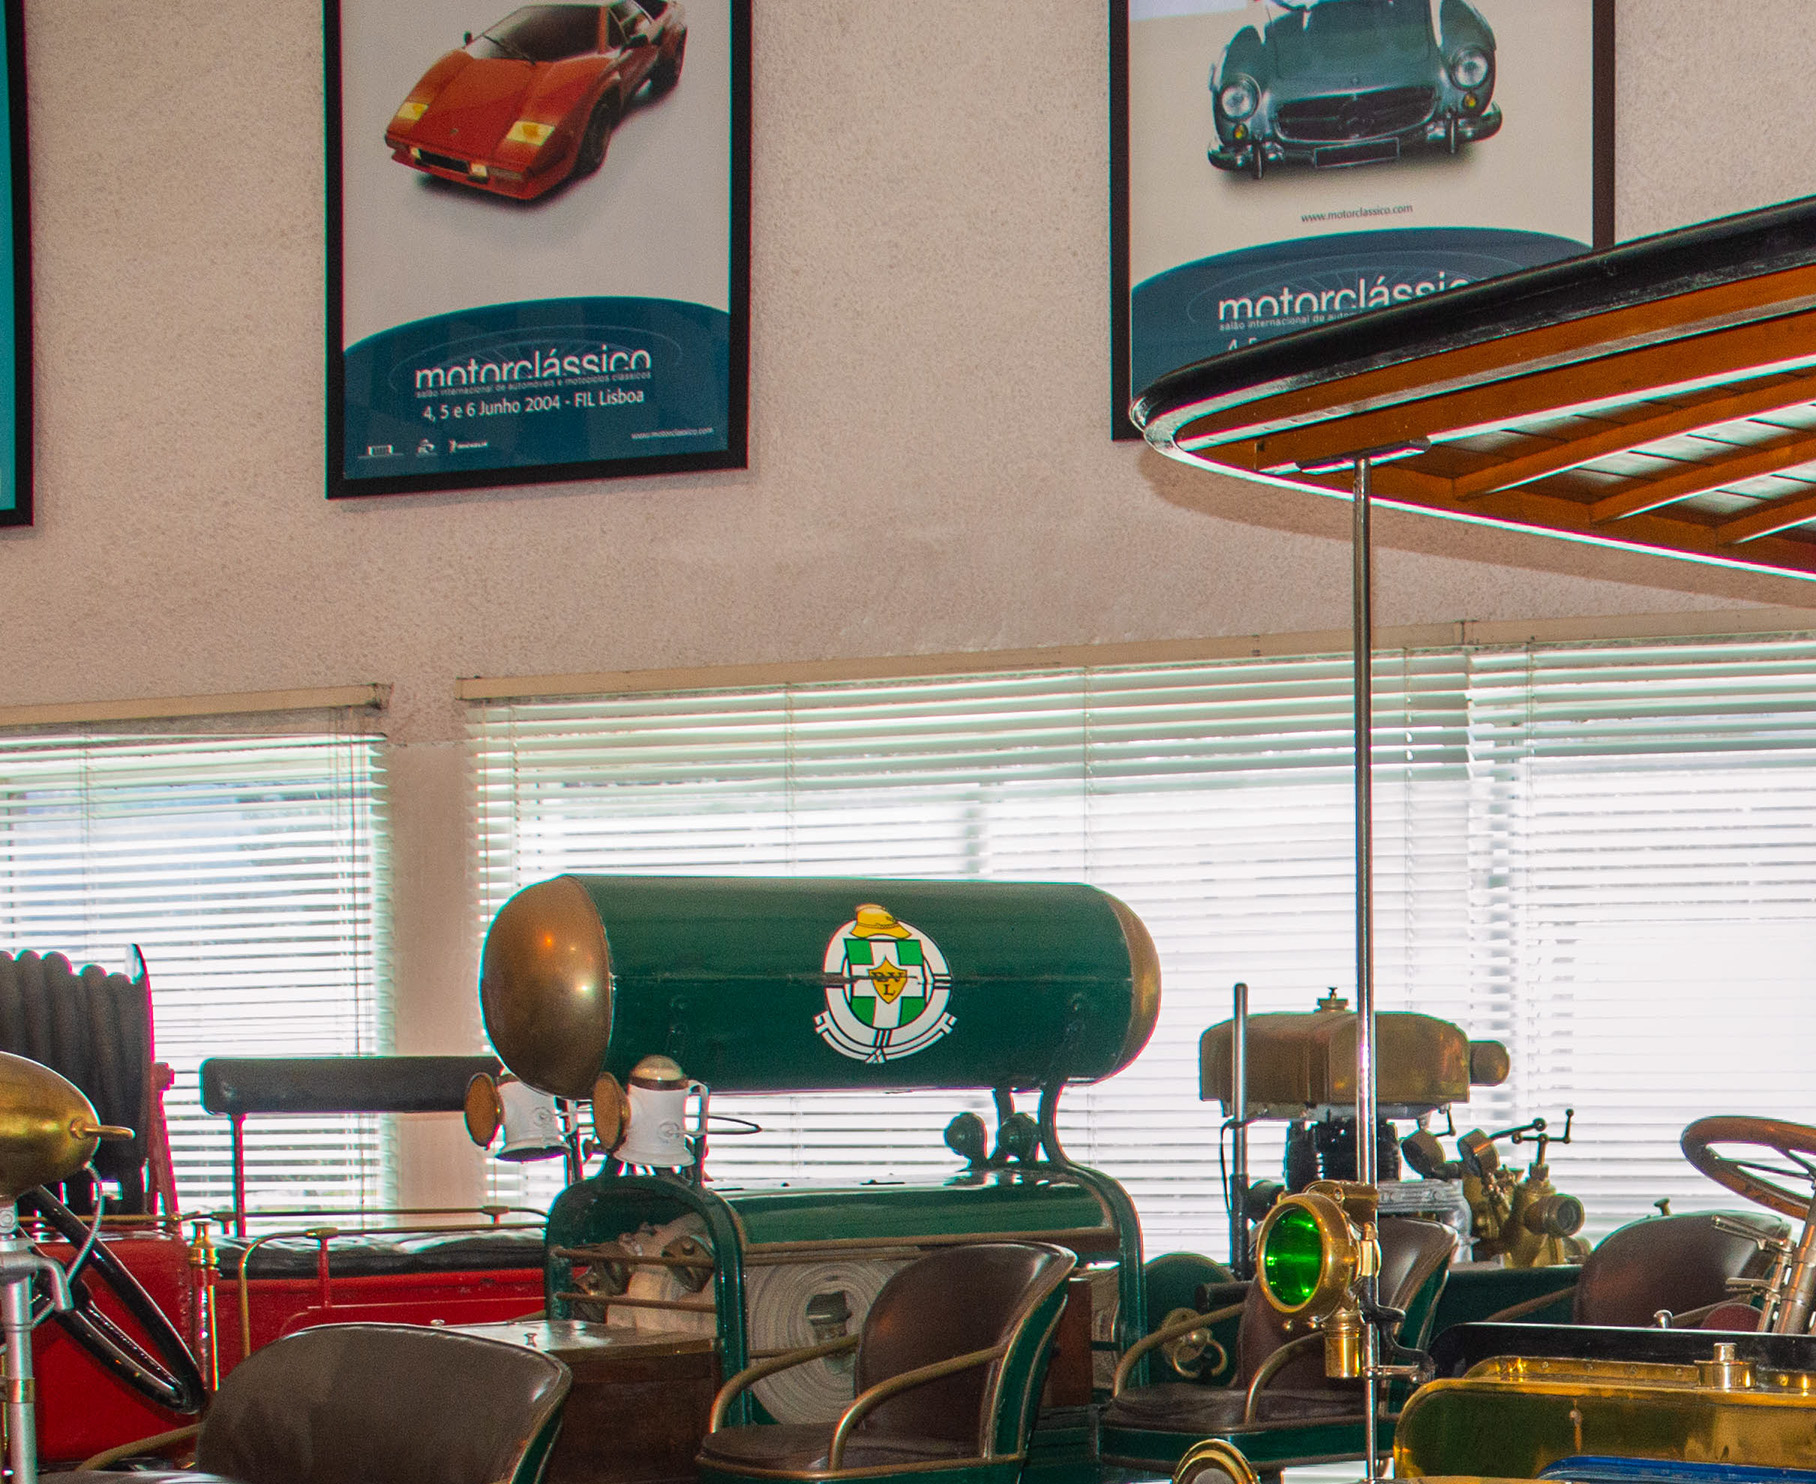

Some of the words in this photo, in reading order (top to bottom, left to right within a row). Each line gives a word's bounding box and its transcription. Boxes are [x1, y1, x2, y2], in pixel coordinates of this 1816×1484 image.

[1247, 314, 1311, 330] internacional
[415, 344, 652, 389] motorclássico
[423, 405, 437, 423] 4,
[440, 404, 450, 420] 5
[453, 406, 463, 418] e
[466, 402, 476, 417] 6
[478, 397, 521, 416] Junho
[525, 395, 561, 413] 2004
[574, 391, 596, 408] FIL
[599, 387, 645, 406] Lisboa
[883, 983, 896, 996] L
